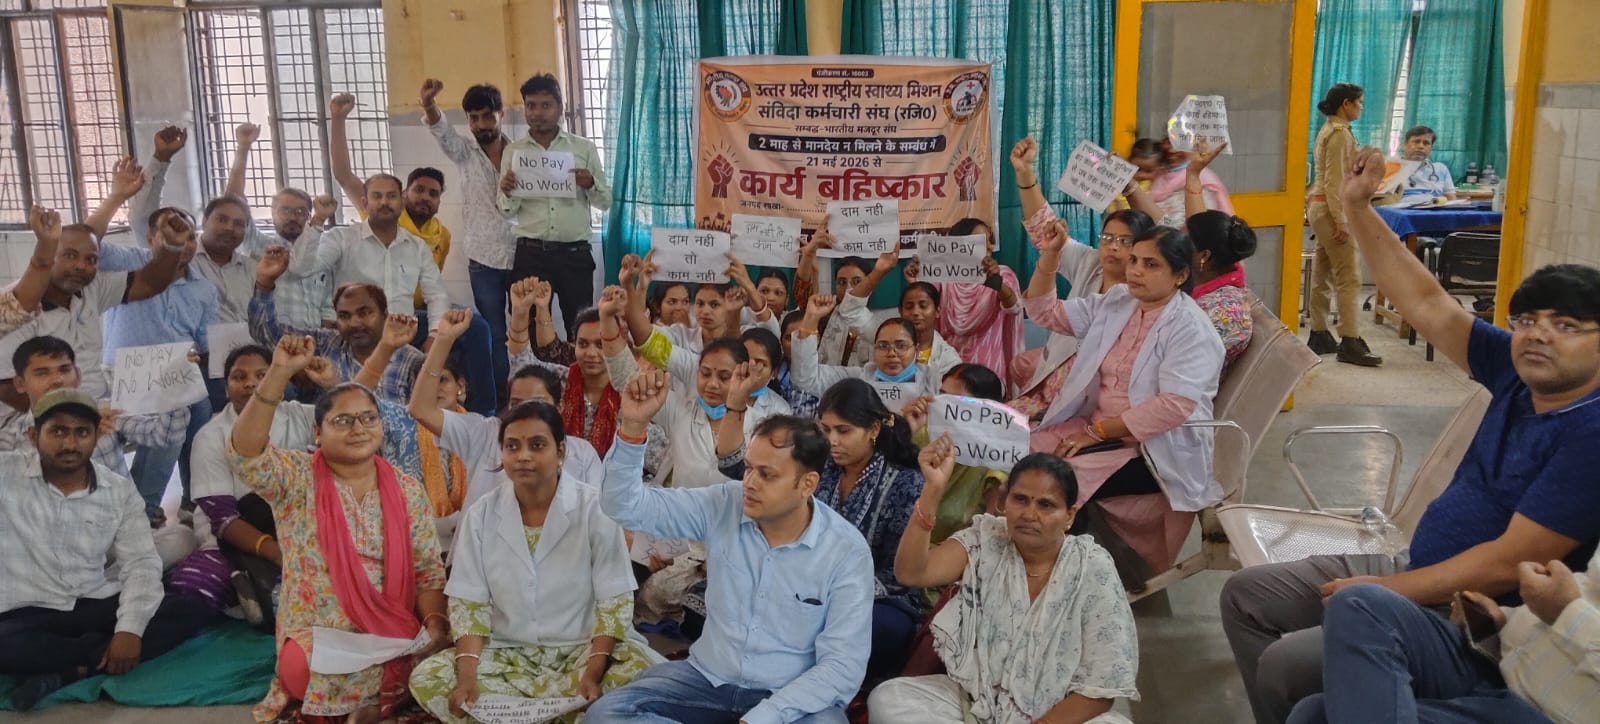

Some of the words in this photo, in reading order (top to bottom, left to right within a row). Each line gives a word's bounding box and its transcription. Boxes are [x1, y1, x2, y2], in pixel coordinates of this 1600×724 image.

[754, 83, 786, 97] उत्तर
[790, 79, 819, 98] प्रदेश
[822, 80, 862, 101] राष्ट्रीय
[907, 80, 941, 98] मिशन
[758, 101, 800, 119] संविदा
[804, 102, 861, 119] कर्मचारी
[866, 104, 890, 119] संघ
[857, 126, 880, 135] मजदूर
[759, 138, 767, 149] 2
[770, 140, 788, 150] माह
[792, 137, 801, 150] से
[805, 138, 839, 151] मानदेय
[843, 142, 850, 151] न
[855, 139, 882, 152] मिलने
[886, 139, 896, 152] के
[519, 156, 537, 168] No
[541, 157, 564, 171] Pay
[806, 156, 818, 167] 21
[822, 155, 837, 168] मई
[840, 157, 869, 168] 2026
[873, 155, 882, 167] से
[516, 179, 534, 191] No
[537, 179, 573, 192] Work
[739, 167, 806, 199] कार्य
[817, 168, 948, 200] बहिष्कार
[841, 206, 859, 217] दाम
[864, 203, 883, 216] नही
[857, 222, 869, 234] तो
[668, 235, 688, 247] दाम
[695, 233, 714, 247] नही
[844, 242, 863, 252] काम
[868, 238, 887, 251] नही
[927, 241, 946, 254] No
[951, 241, 976, 256] Pay
[684, 250, 697, 265] तो
[666, 271, 690, 281] काम
[695, 269, 715, 281] नही
[922, 264, 942, 277] No
[945, 264, 984, 278] Work
[147, 367, 197, 392] WORK
[879, 385, 901, 400] नही
[944, 403, 972, 423] No
[979, 406, 1015, 430] Pay
[967, 442, 1023, 464] Work
